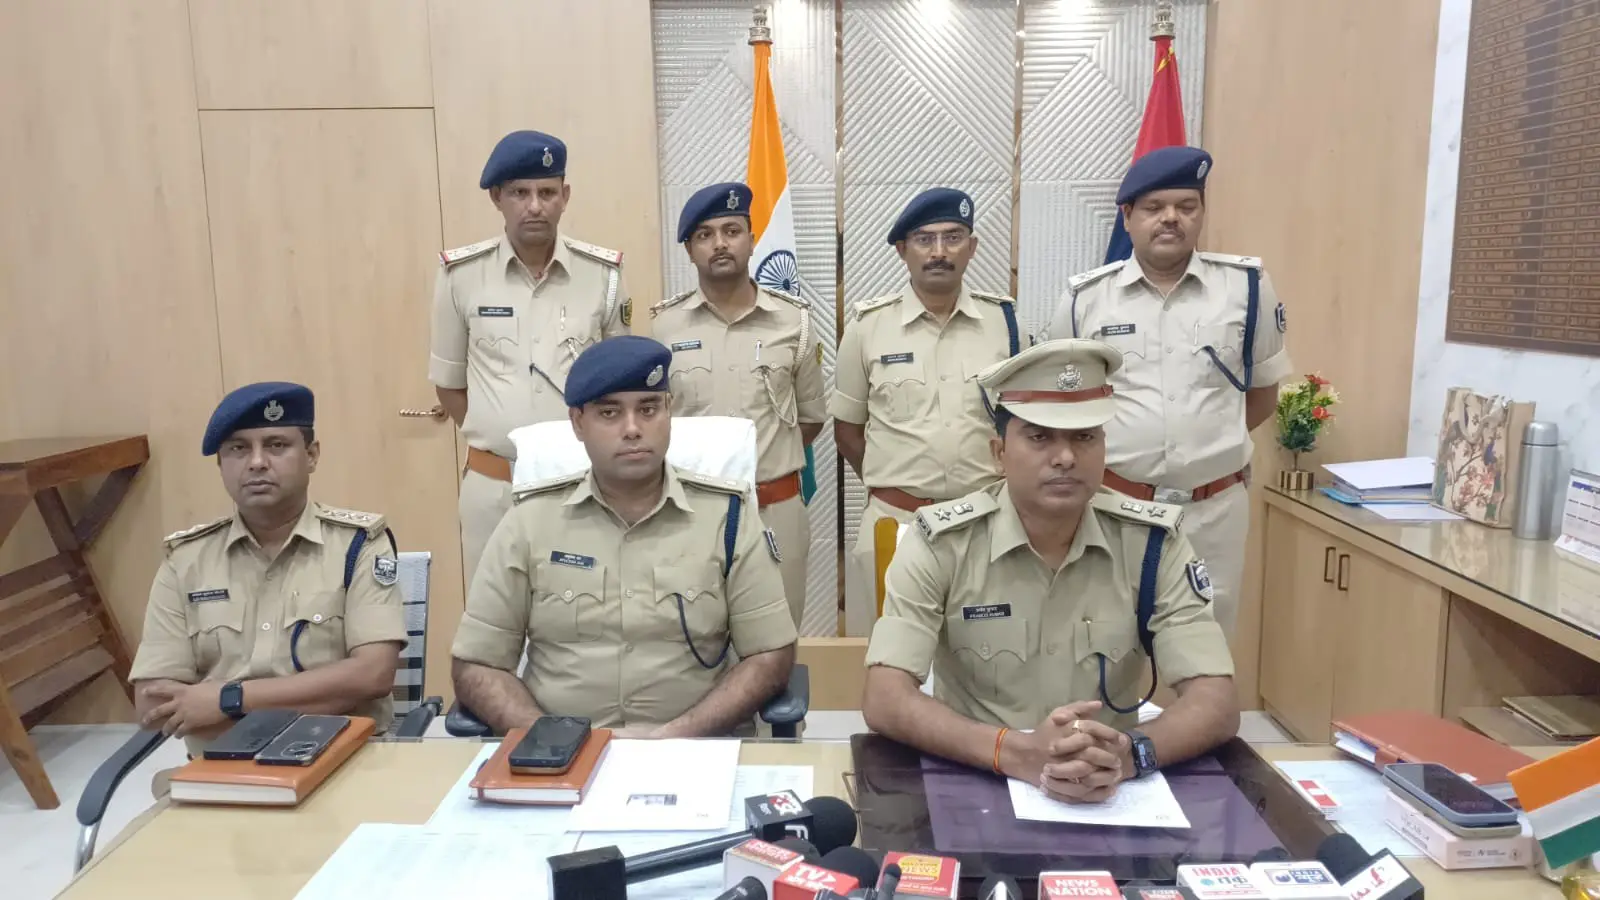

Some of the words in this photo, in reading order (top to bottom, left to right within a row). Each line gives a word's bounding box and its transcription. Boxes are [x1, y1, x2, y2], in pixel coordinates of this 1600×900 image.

[1192, 866, 1241, 876] INDIA
[1055, 879, 1099, 887] NEWS
[1046, 886, 1113, 896] NATION
